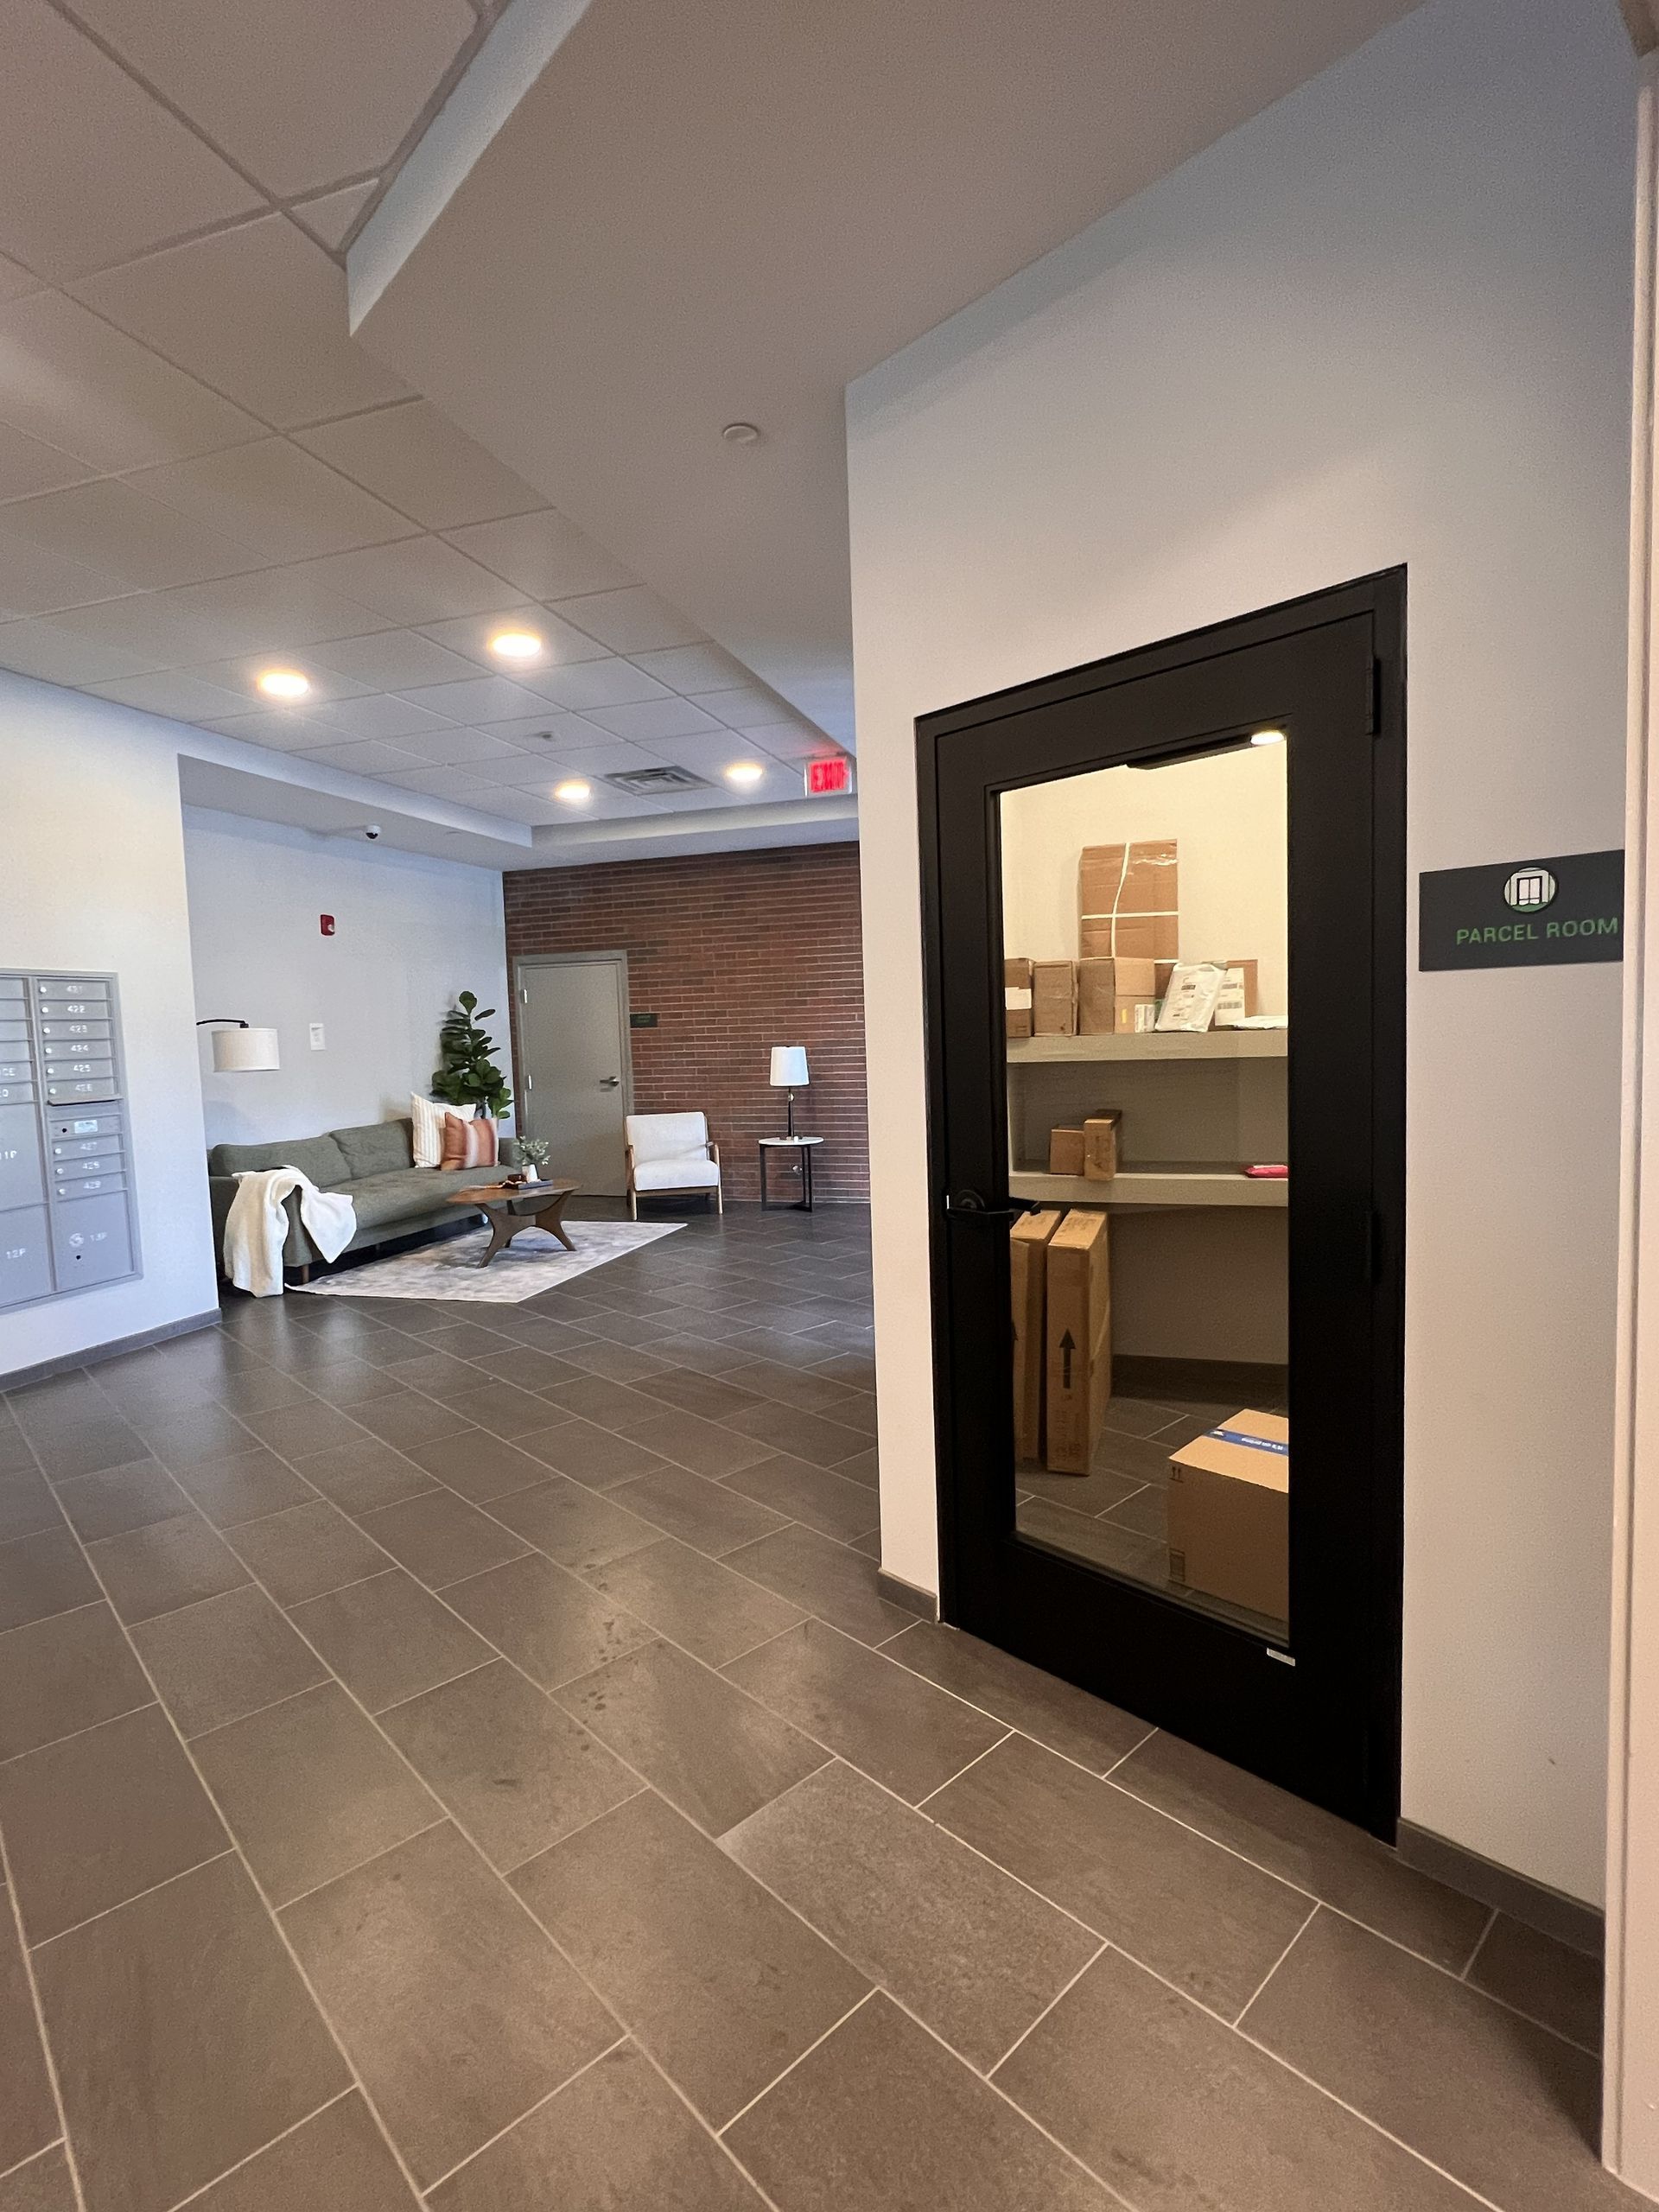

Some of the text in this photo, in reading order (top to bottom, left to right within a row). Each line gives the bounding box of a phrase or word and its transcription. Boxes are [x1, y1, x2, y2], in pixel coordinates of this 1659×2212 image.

[1456, 917, 1618, 945] PARCEL ROOM
[67, 1005, 86, 1014] 422
[73, 1064, 91, 1072] 425
